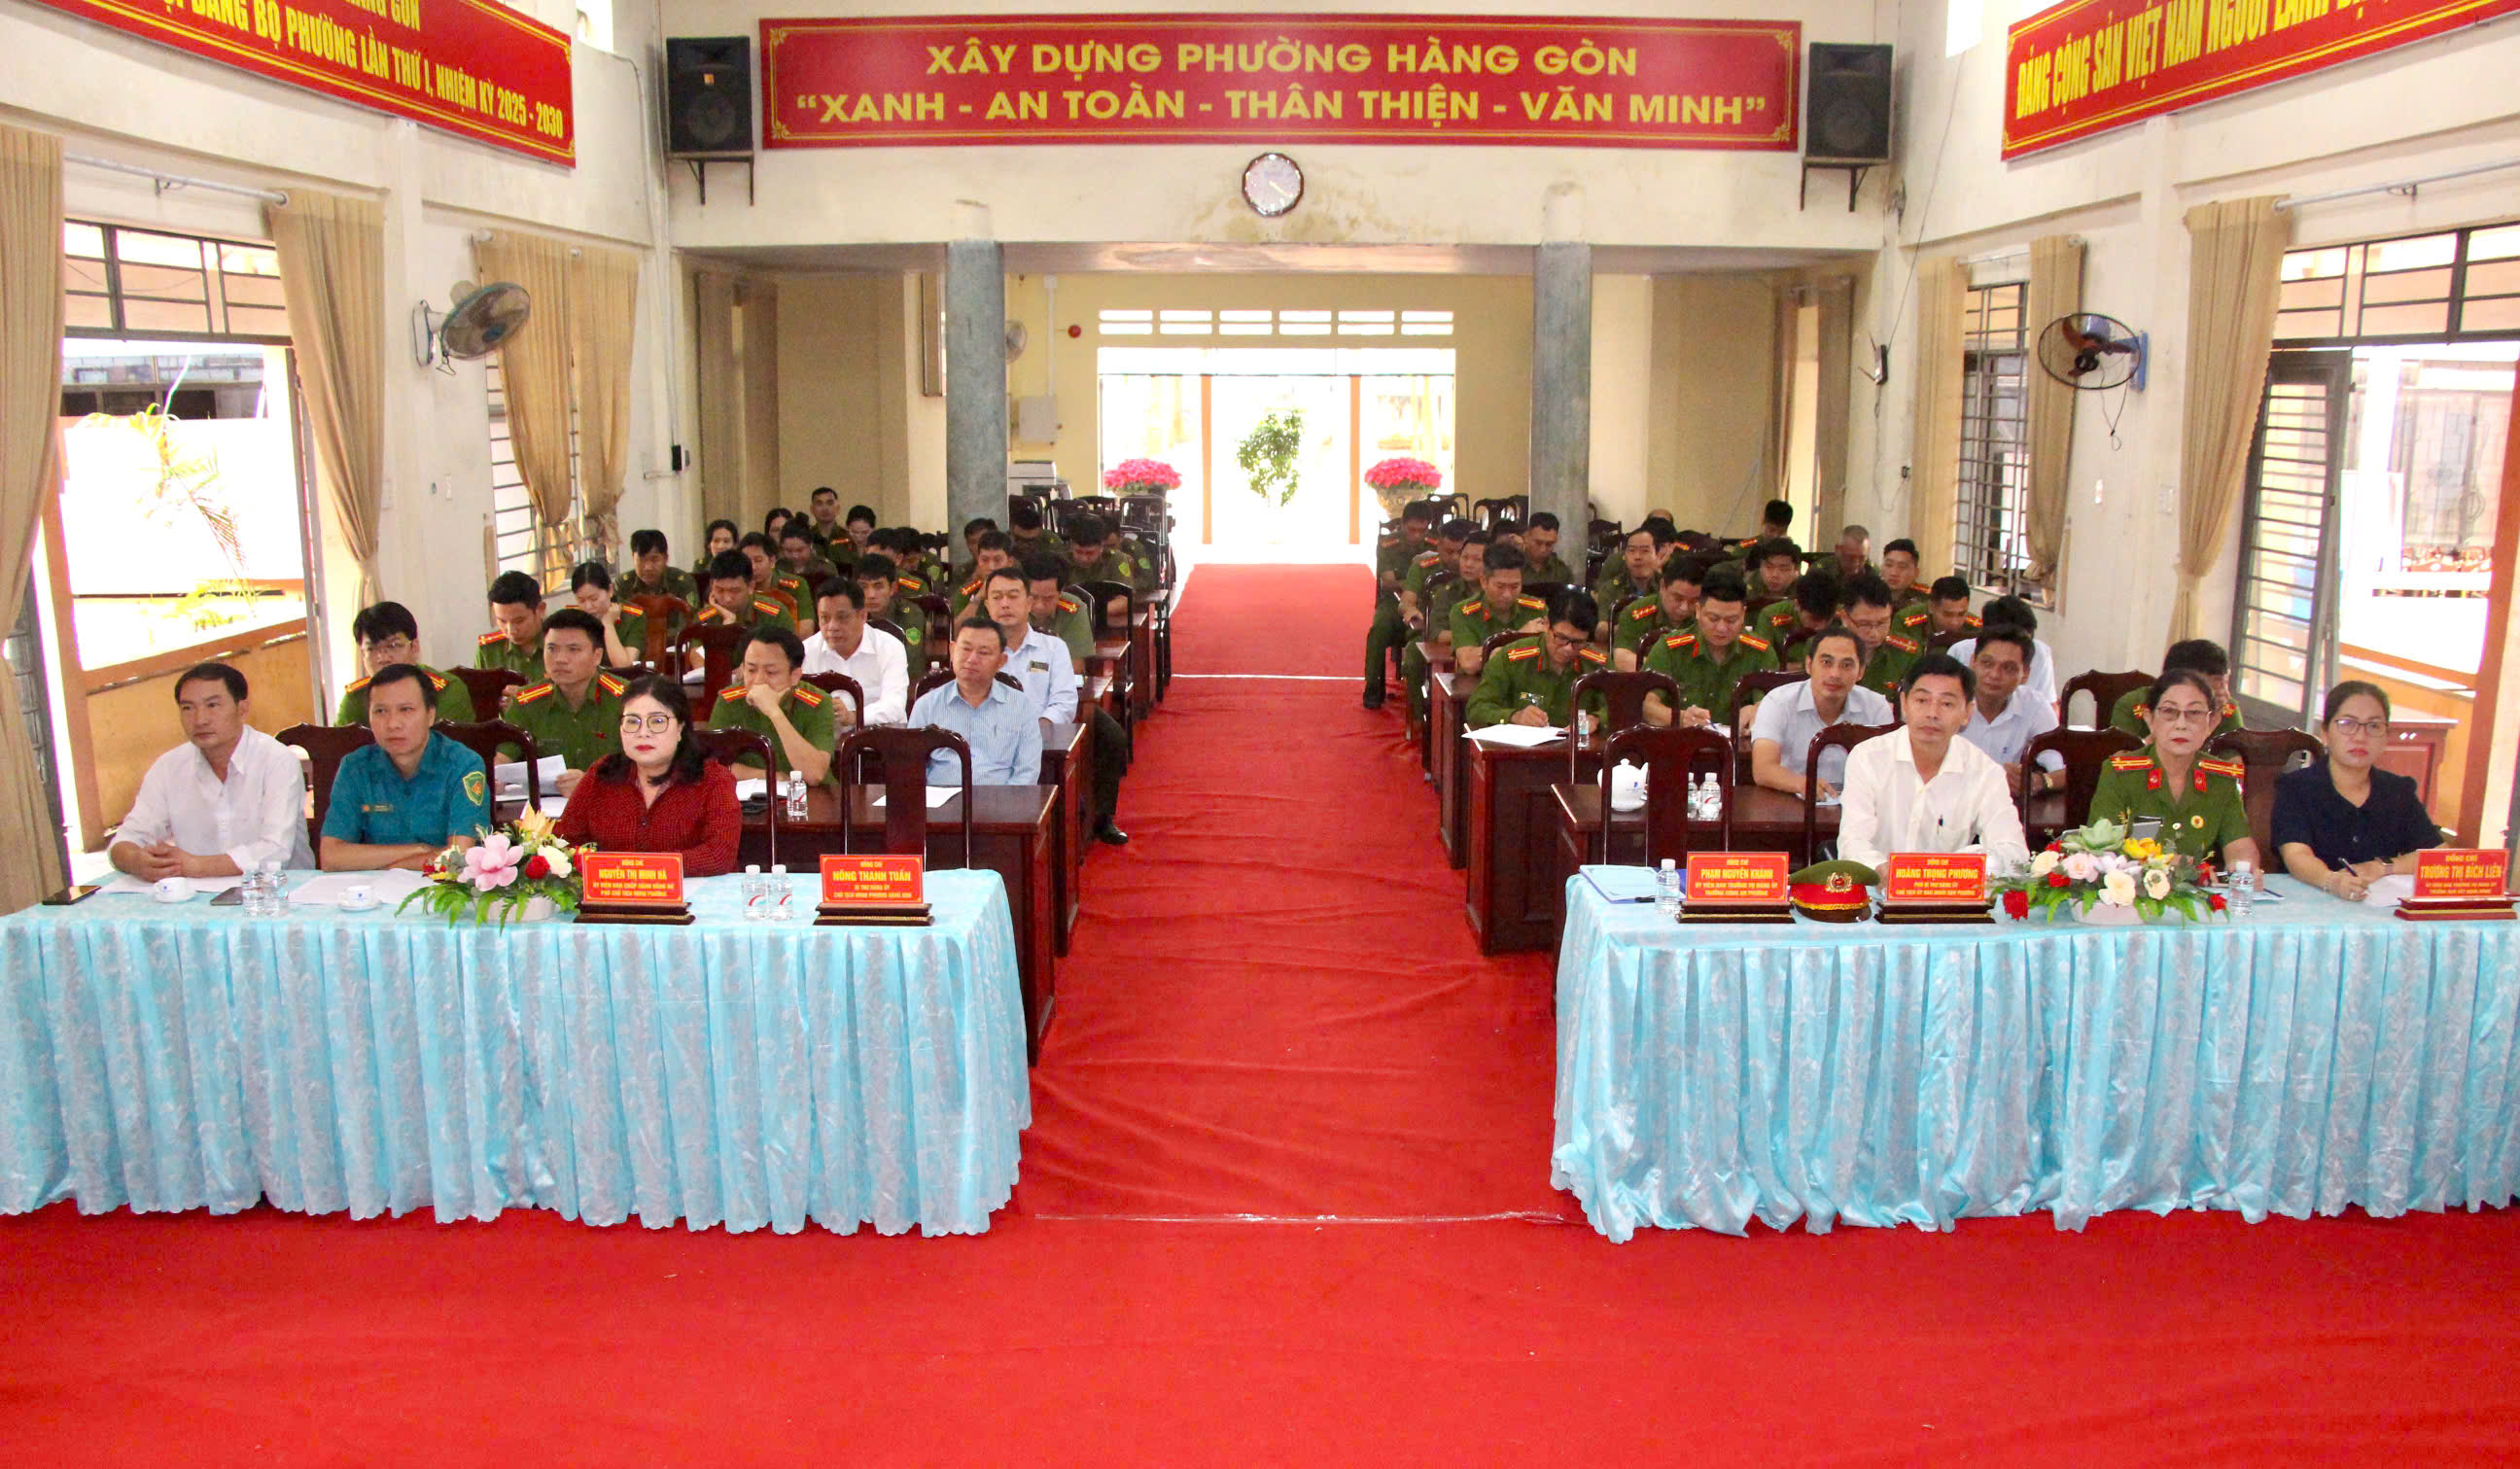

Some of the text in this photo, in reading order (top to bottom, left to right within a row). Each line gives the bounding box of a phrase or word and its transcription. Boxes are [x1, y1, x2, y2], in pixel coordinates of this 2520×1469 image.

[286, 6, 358, 68] PHƯỜNG
[361, 24, 389, 79] LẦN
[392, 47, 421, 90] THỨ
[437, 63, 476, 112] NHIỆM
[479, 78, 494, 115] KỲ
[498, 87, 527, 126] 2025
[537, 101, 564, 138] 2030
[927, 36, 1637, 82] XÂY DỰNG PHƯỜNG HÀNG GÒN
[2015, 44, 2051, 120] ĐẢNG
[2052, 32, 2090, 115] CỘNG
[2092, 10, 2124, 93] SẢN
[2125, 0, 2163, 89] VIỆT
[2162, 0, 2204, 70] NAM
[958, 103, 973, 113] -
[985, 91, 1049, 120] AN
[1063, 82, 1185, 120] TOÀN
[1199, 103, 1212, 113] -
[1225, 84, 1344, 120] THÂN
[1357, 84, 1480, 128] THIỆN
[1492, 103, 1507, 113] -
[1520, 86, 1613, 122] VĂN
[858, 871, 887, 882] THANH
